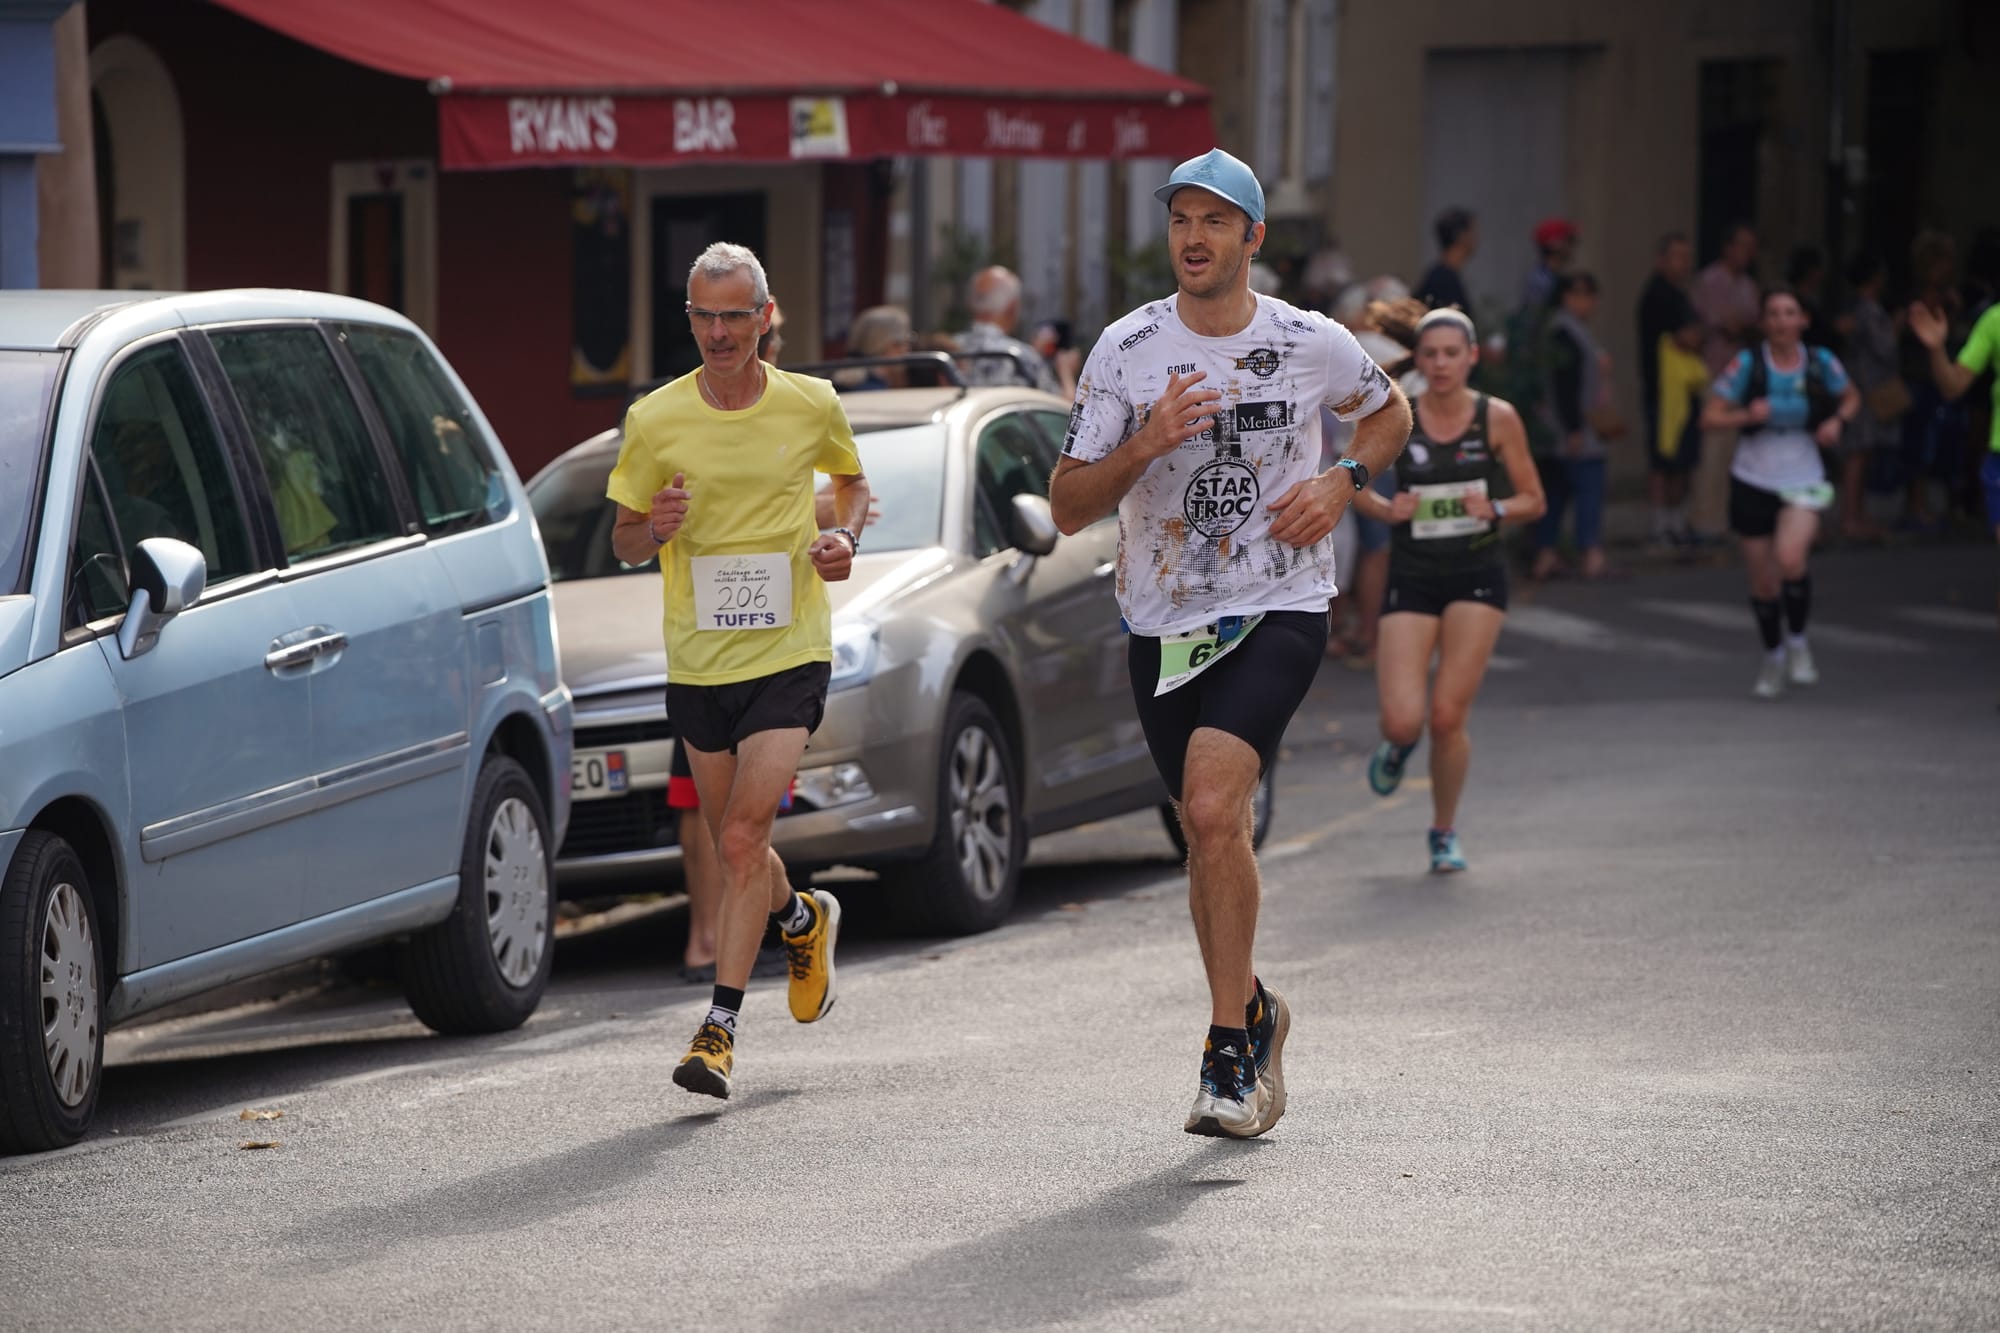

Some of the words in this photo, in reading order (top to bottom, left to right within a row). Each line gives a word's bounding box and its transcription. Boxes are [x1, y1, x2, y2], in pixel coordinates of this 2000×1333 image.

[507, 97, 617, 153] RYAN'S
[671, 97, 738, 153] BAR
[1167, 362, 1197, 376] GOBIK
[1240, 415, 1286, 430] Mende
[1193, 477, 1252, 497] STAR
[1190, 497, 1252, 519] TROC
[717, 583, 768, 611] 206
[713, 612, 776, 627] TUFF'S
